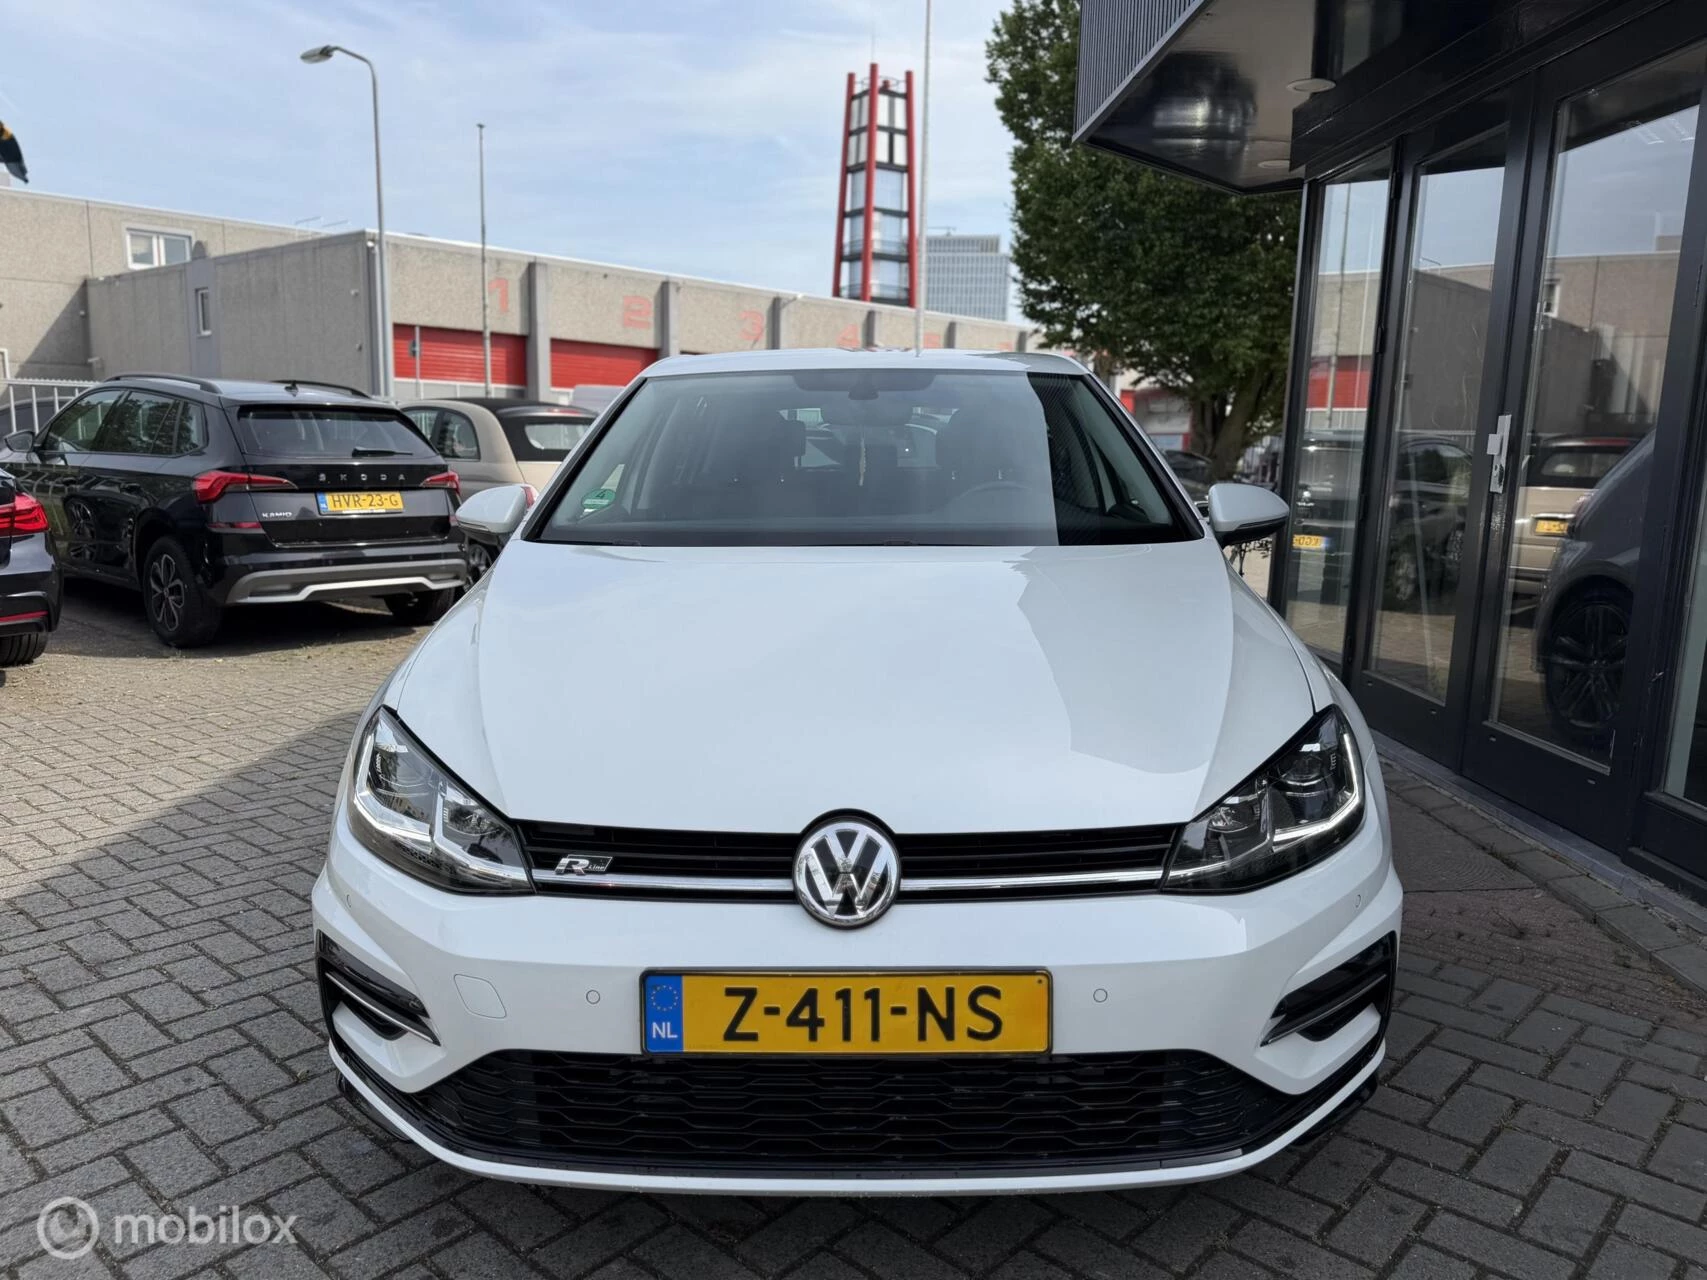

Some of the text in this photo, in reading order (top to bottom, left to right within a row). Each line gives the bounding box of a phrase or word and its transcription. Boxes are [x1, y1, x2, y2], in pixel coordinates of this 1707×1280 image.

[488, 278, 508, 313] 1
[622, 295, 652, 329] 2
[739, 310, 764, 341] 3
[331, 494, 399, 508] HVR-23-G
[651, 1021, 678, 1039] NL
[723, 985, 1003, 1043] Z-411-NS
